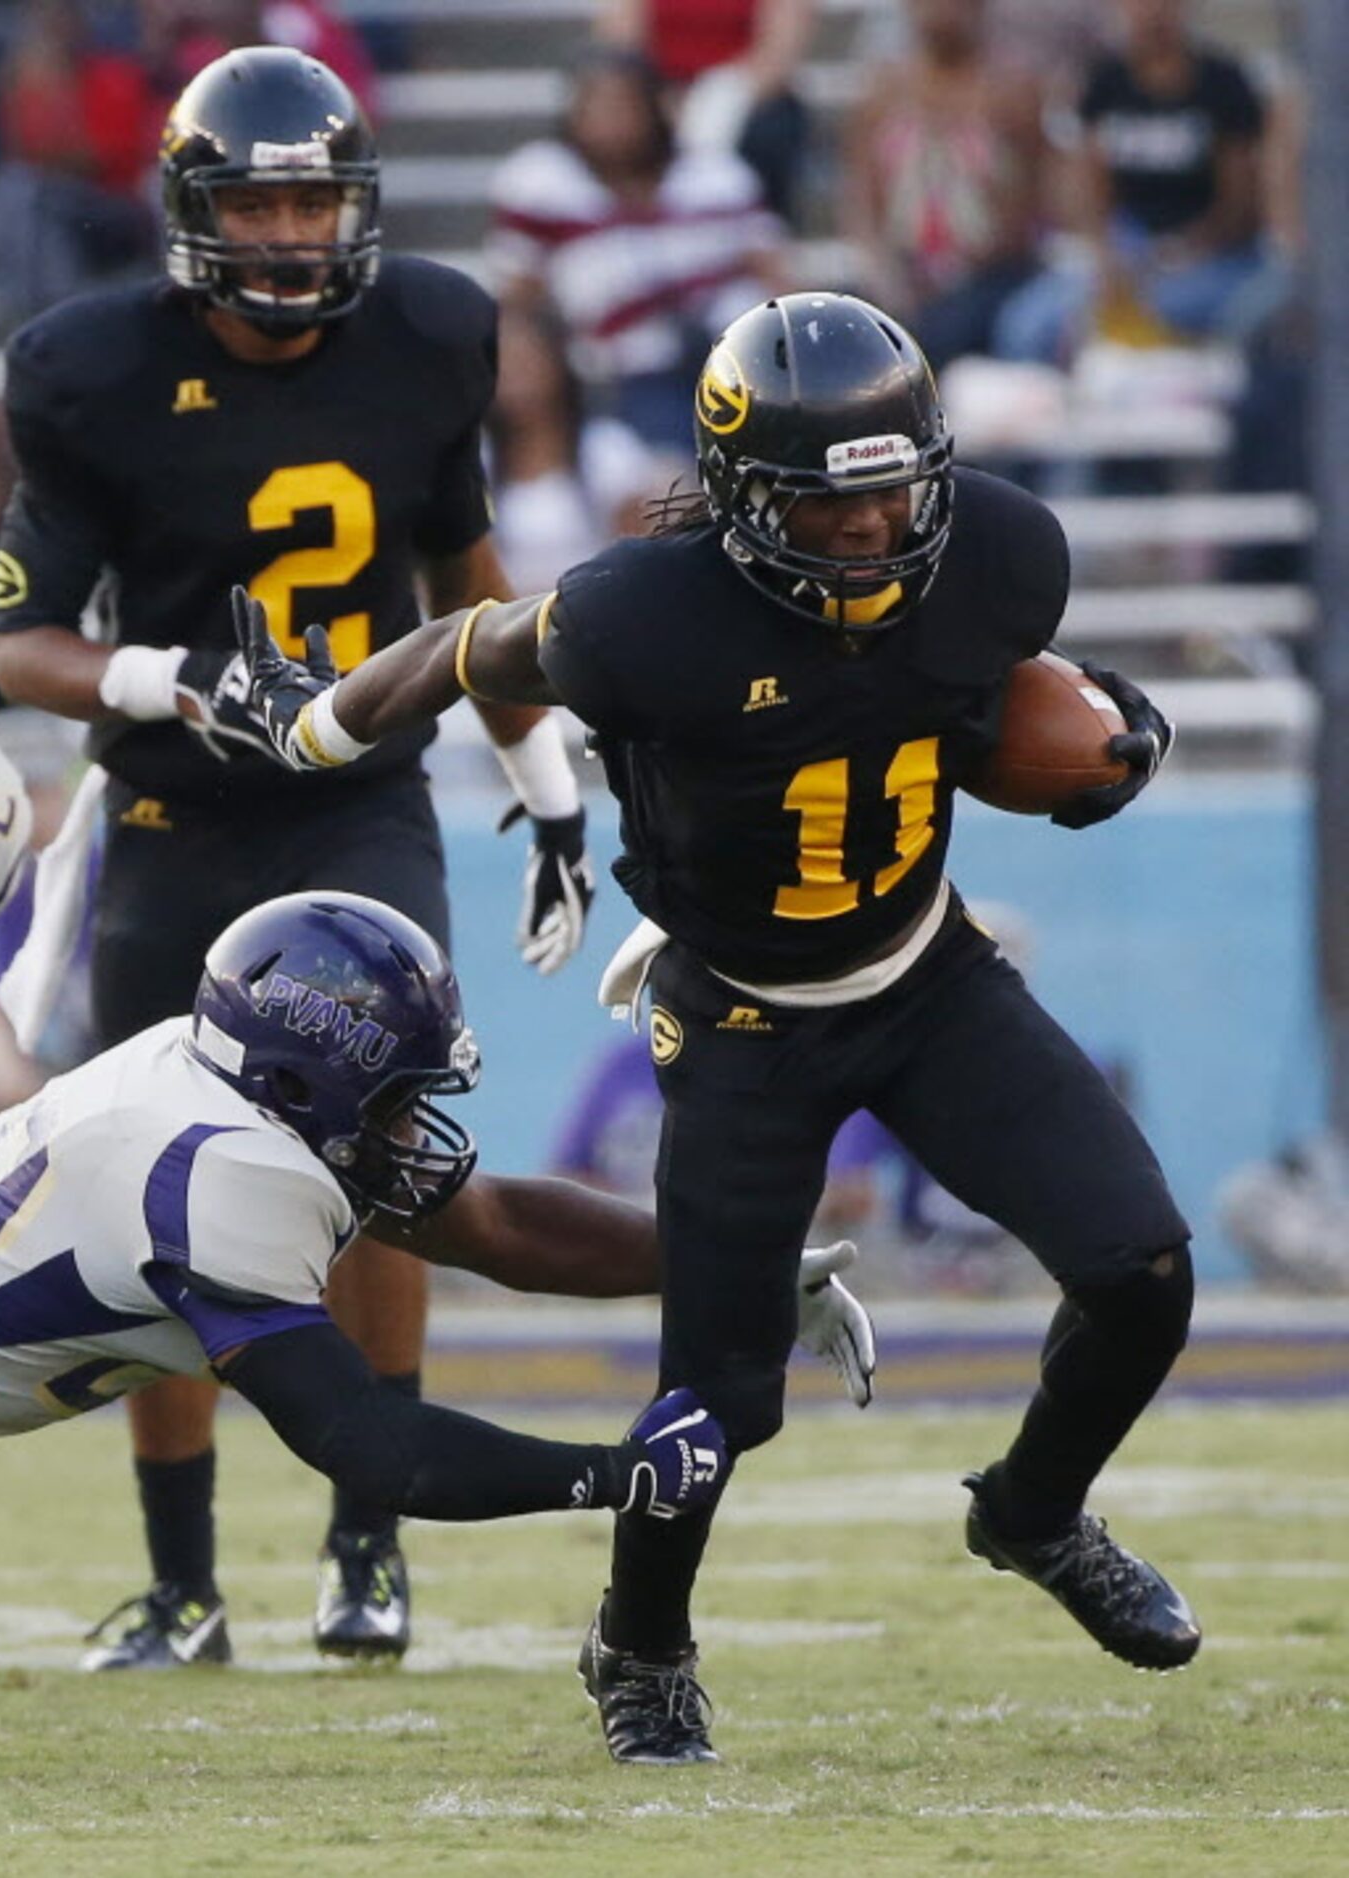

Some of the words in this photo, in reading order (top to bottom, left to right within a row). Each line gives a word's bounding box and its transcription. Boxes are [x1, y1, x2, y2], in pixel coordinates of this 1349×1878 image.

[847, 440, 894, 461] Riddell
[248, 460, 376, 675] 2
[772, 736, 940, 920] 11
[254, 973, 400, 1072] PVAMU
[676, 1437, 695, 1500] RUSSELL
[692, 1447, 718, 1483] R
